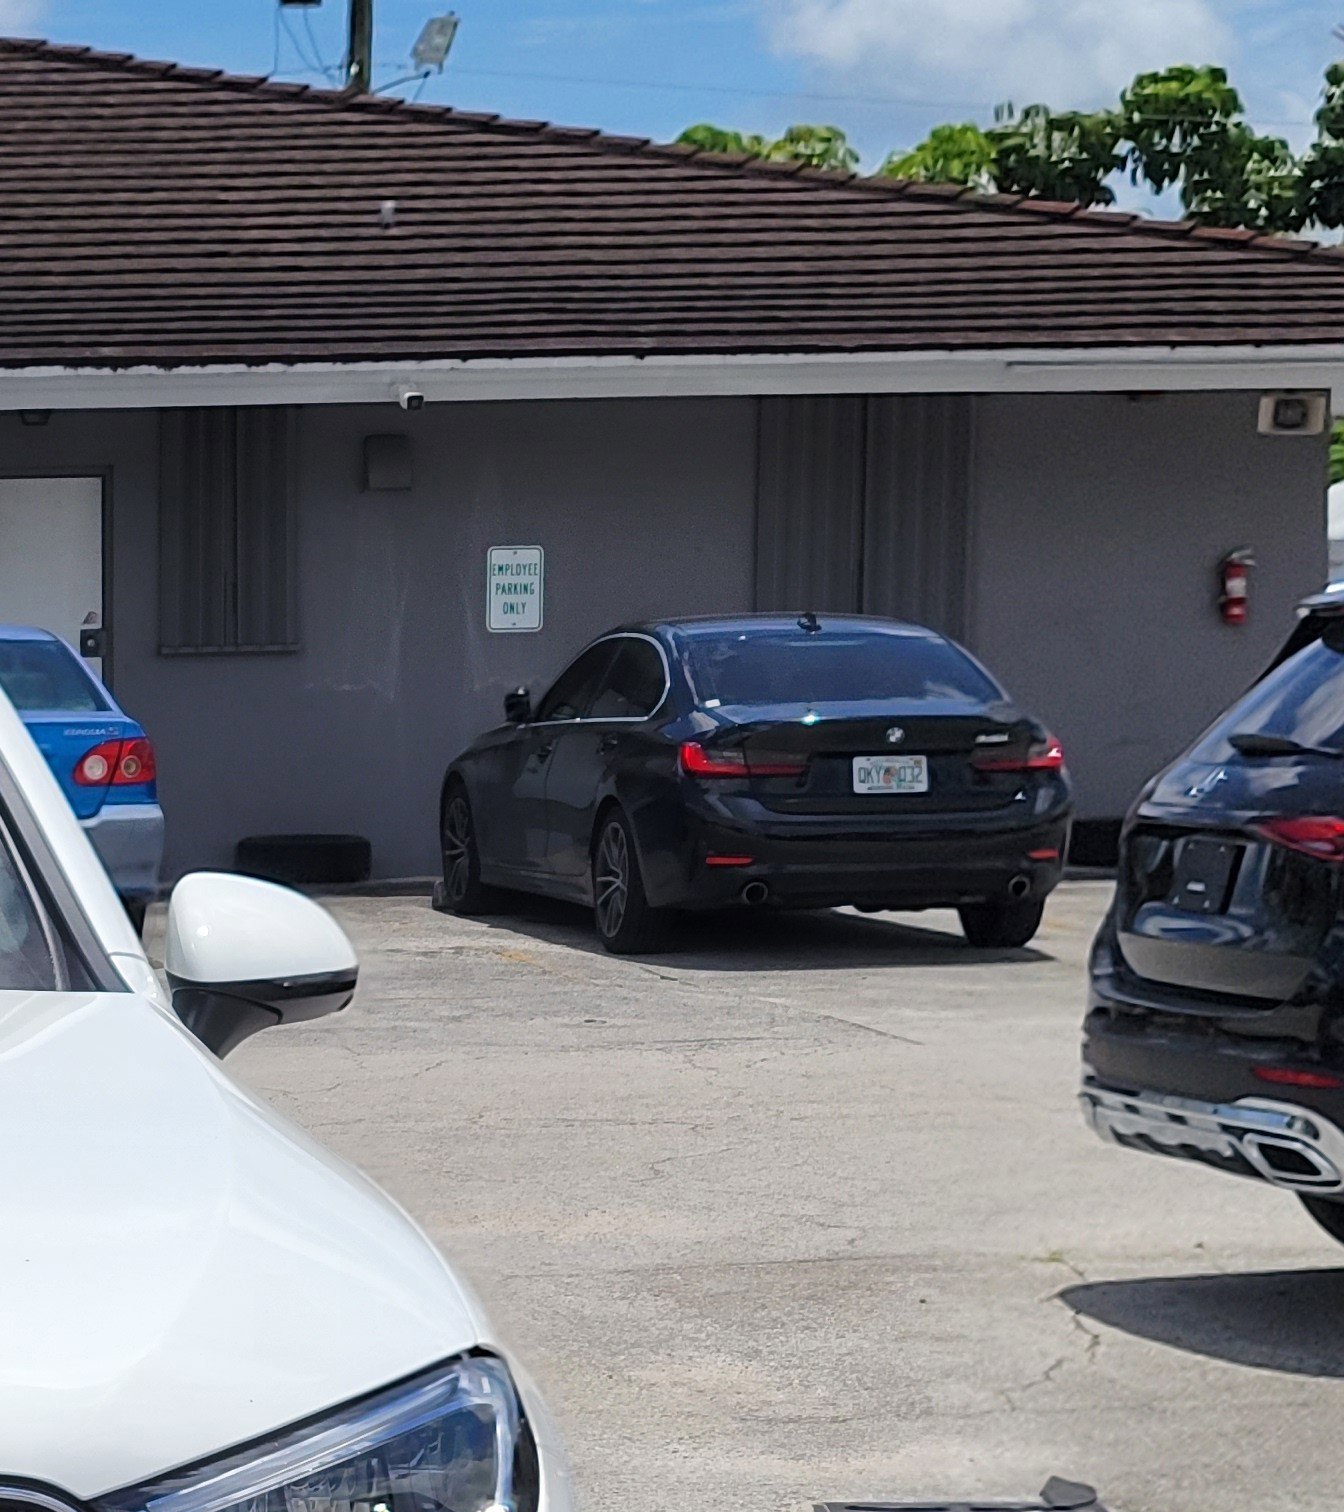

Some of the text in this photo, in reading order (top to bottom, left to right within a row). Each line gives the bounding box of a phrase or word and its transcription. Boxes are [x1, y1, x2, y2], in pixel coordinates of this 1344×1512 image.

[492, 563, 538, 576] EMPLOYEE
[495, 582, 535, 596] PARKING
[502, 602, 526, 615] ONLY
